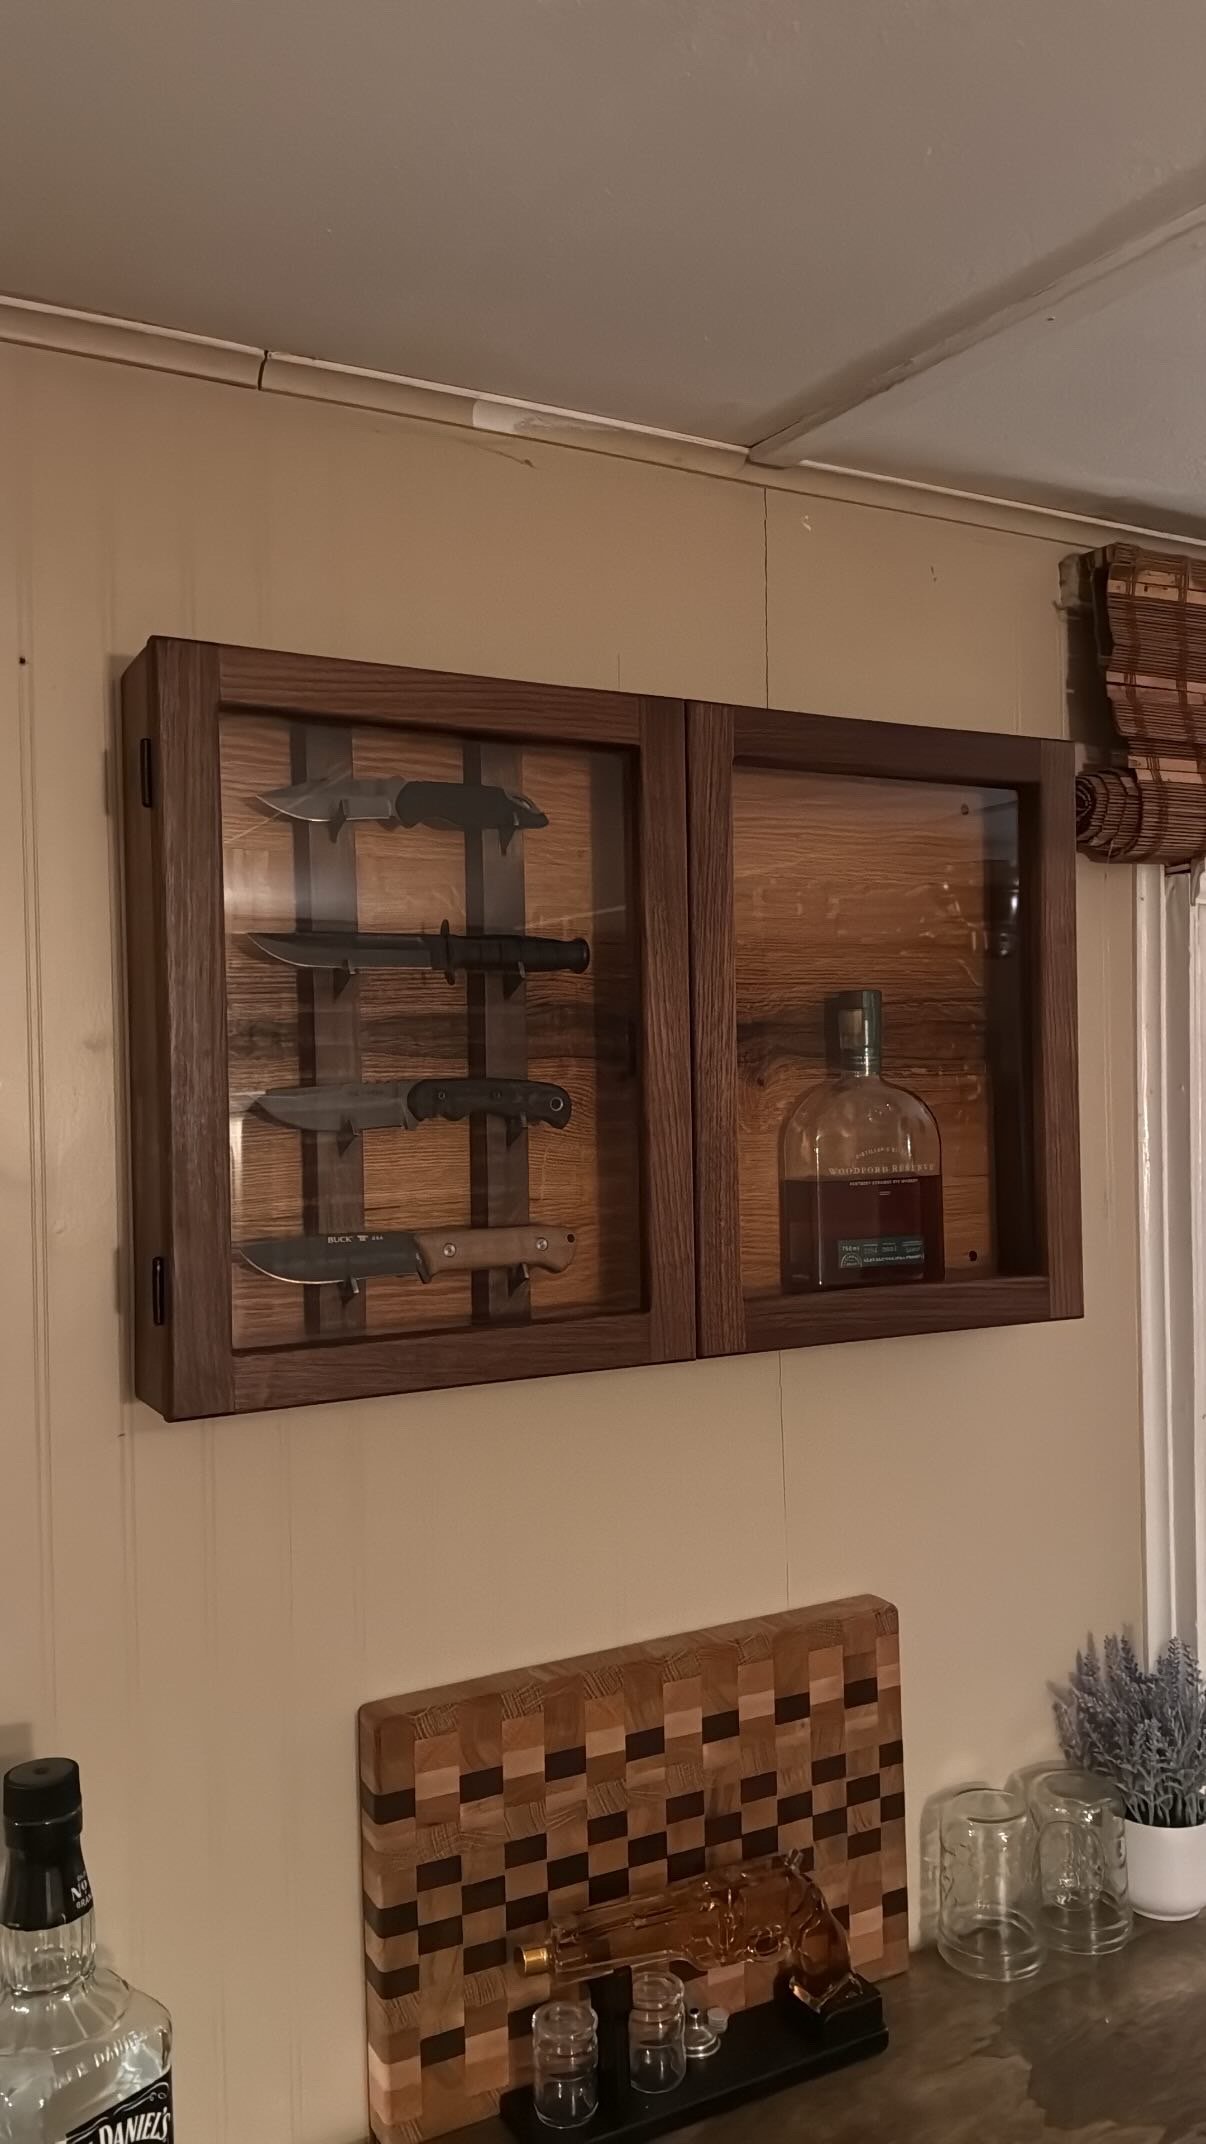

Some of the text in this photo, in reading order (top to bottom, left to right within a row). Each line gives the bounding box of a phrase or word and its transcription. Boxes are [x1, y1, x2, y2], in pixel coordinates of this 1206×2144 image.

[828, 1163, 935, 1176] WOODFORD RESERVE
[327, 1236, 352, 1244] BUCK
[99, 2105, 171, 2144] DANIEL'S
